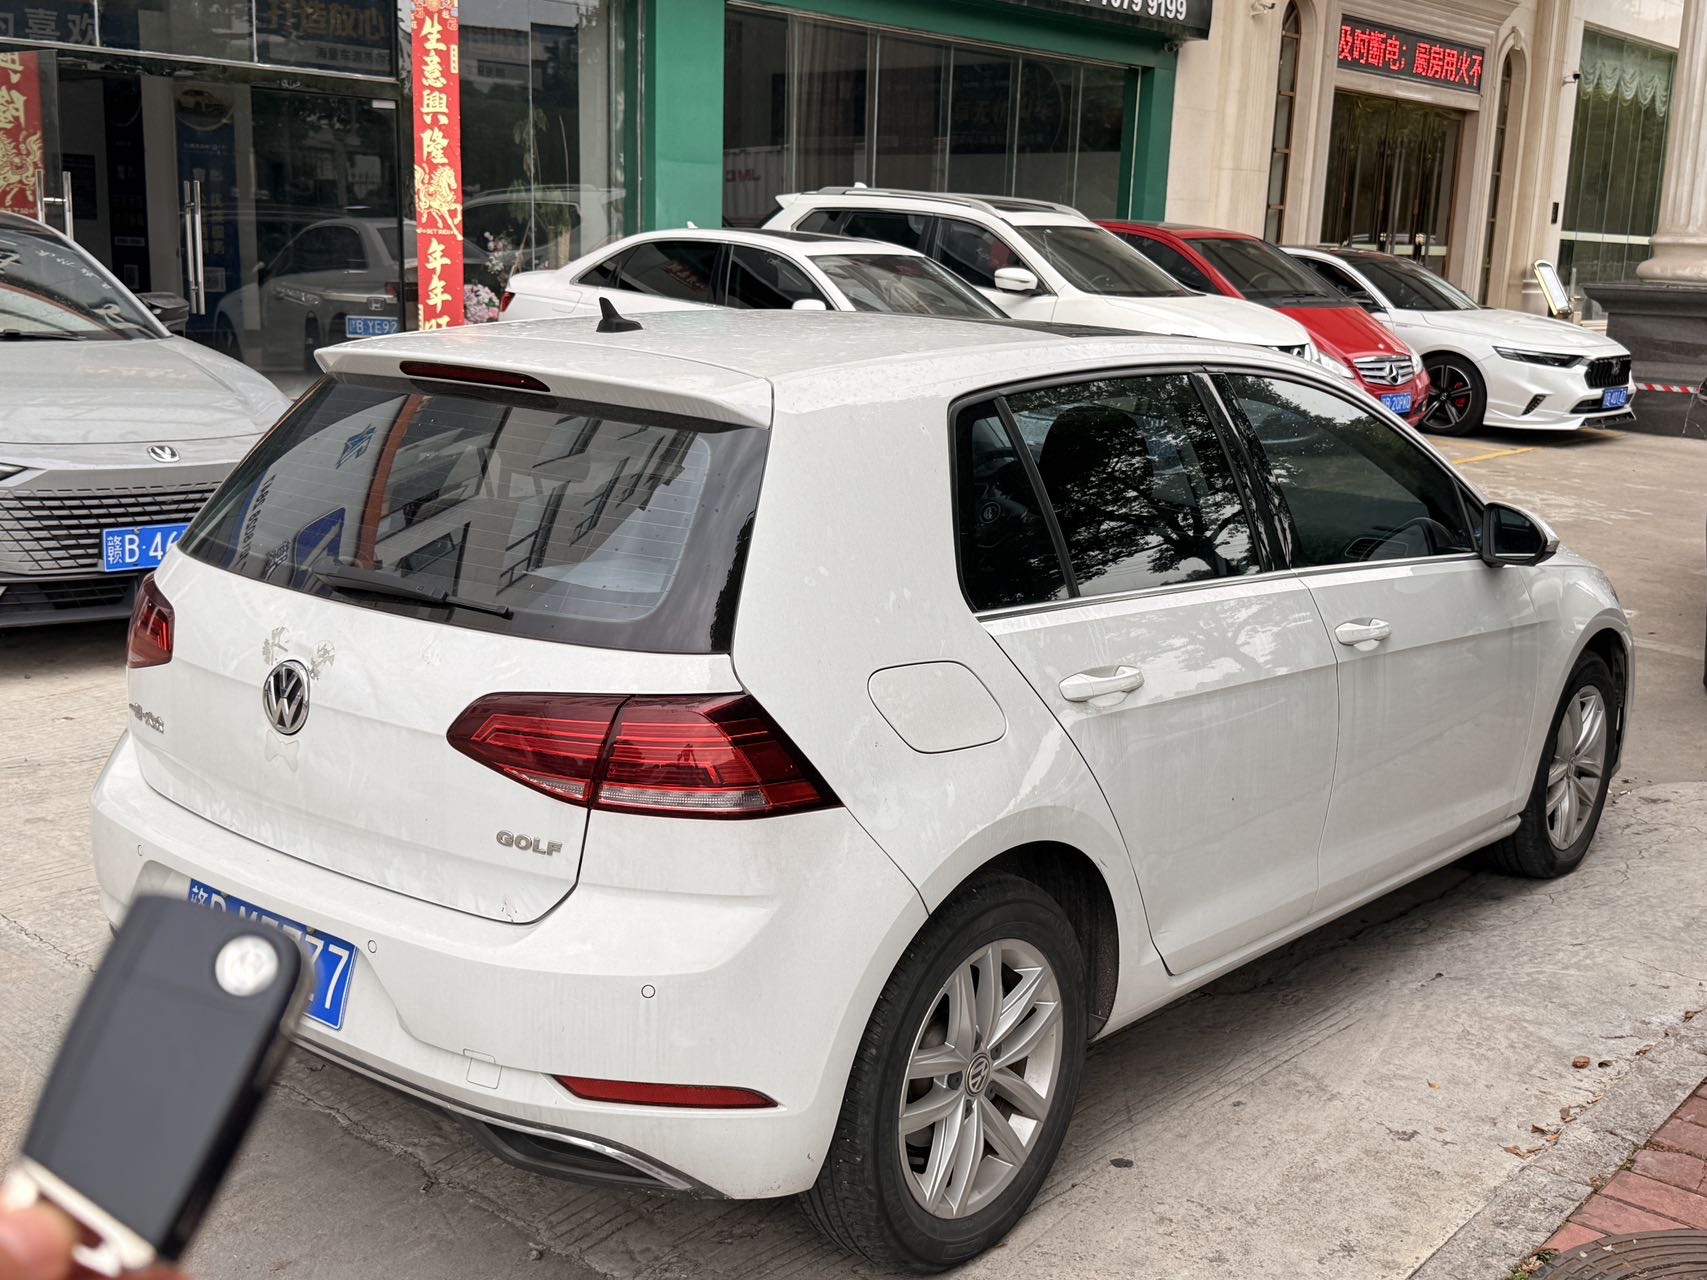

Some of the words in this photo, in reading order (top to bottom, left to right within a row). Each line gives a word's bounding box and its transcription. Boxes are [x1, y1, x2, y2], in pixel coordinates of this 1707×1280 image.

[1147, 0, 1187, 21] 9199
[419, 12, 449, 164] 生意興隆
[107, 531, 186, 564] 赣B·4
[496, 830, 563, 856] GOLF
